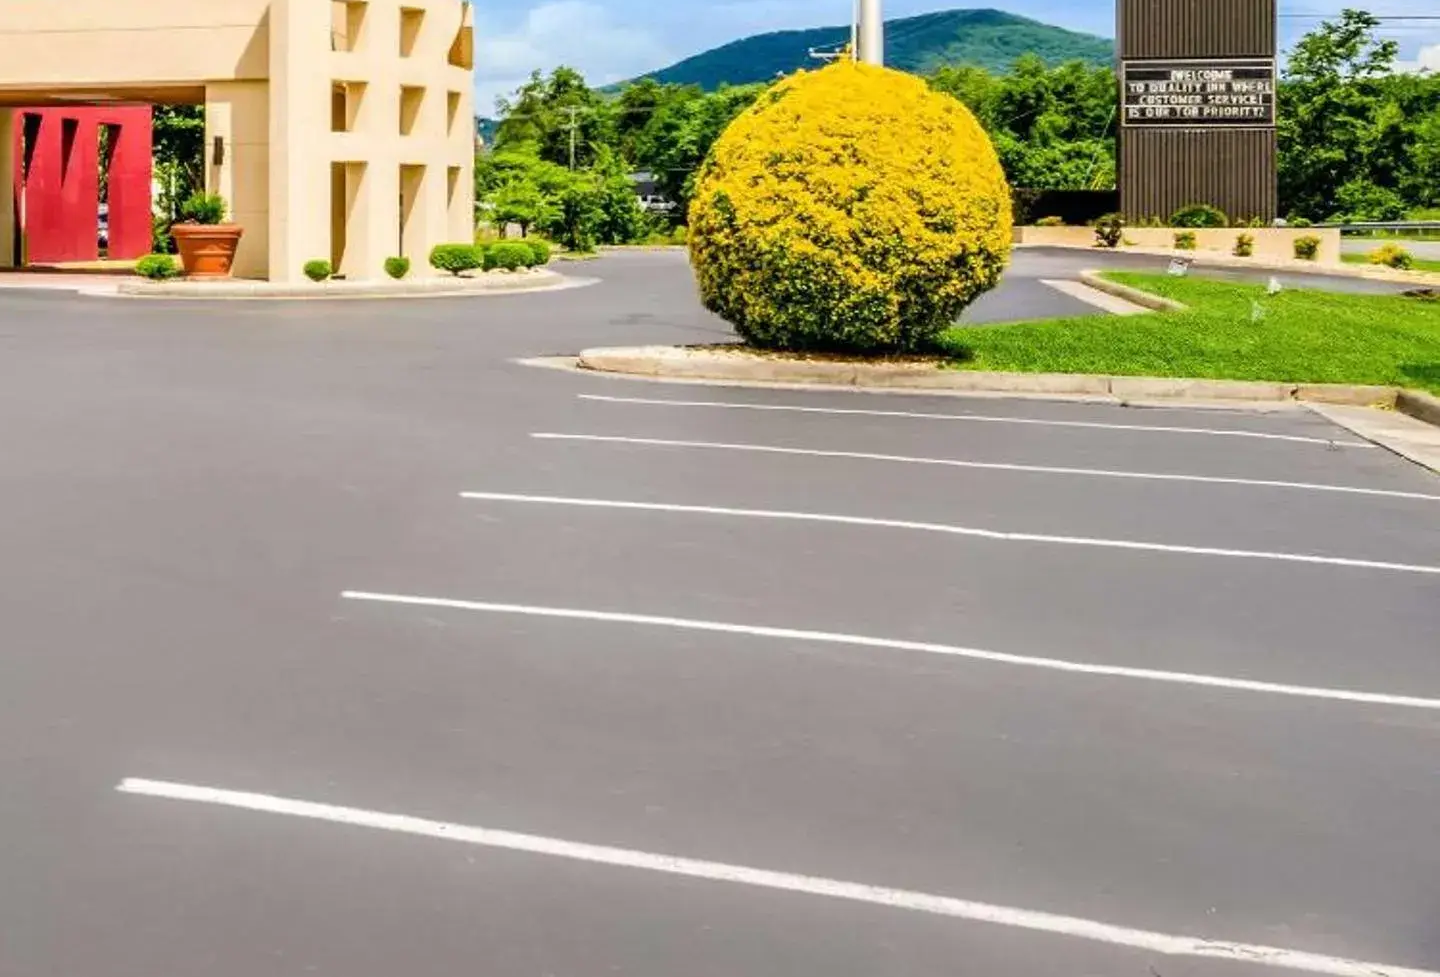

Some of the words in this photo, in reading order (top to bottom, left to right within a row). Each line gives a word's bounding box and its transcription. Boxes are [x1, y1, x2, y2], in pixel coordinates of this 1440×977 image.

[1128, 83, 1145, 93] TO
[1149, 82, 1202, 93] QUALITY
[1207, 82, 1227, 93] INN
[1140, 94, 1203, 104] CUSTOMER
[1129, 107, 1140, 117] IS
